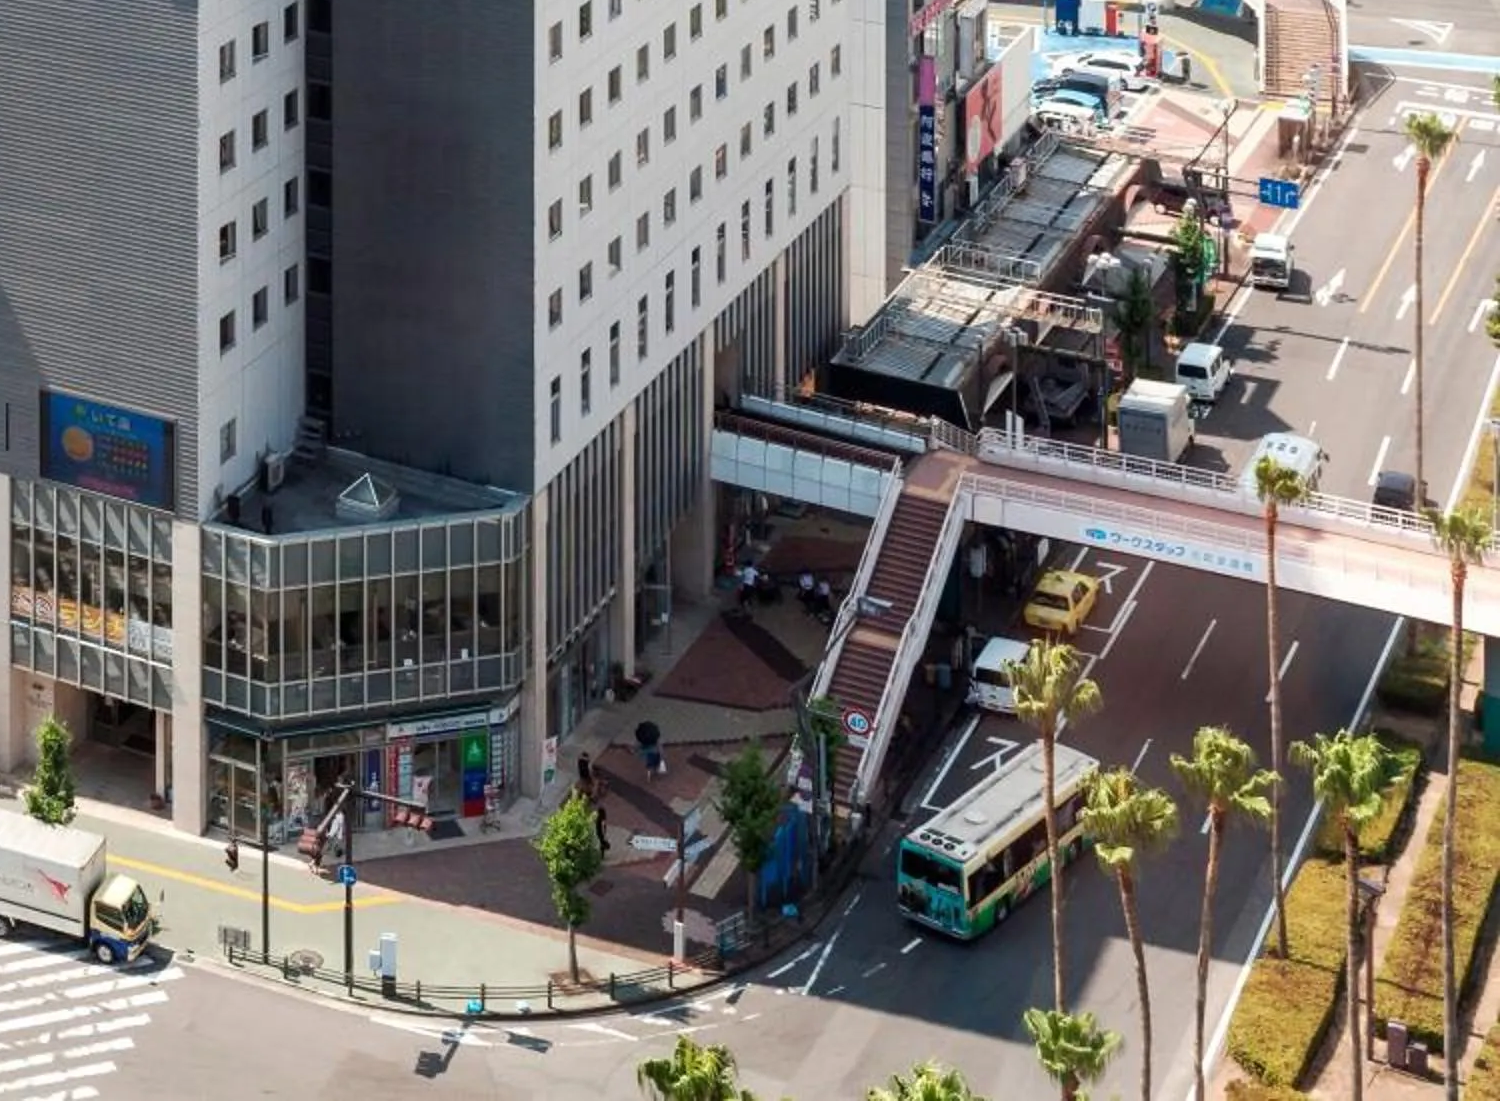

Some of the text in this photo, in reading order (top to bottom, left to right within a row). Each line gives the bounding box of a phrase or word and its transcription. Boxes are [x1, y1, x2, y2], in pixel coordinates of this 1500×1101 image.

[1110, 532, 1186, 557] ワークスタッフ
